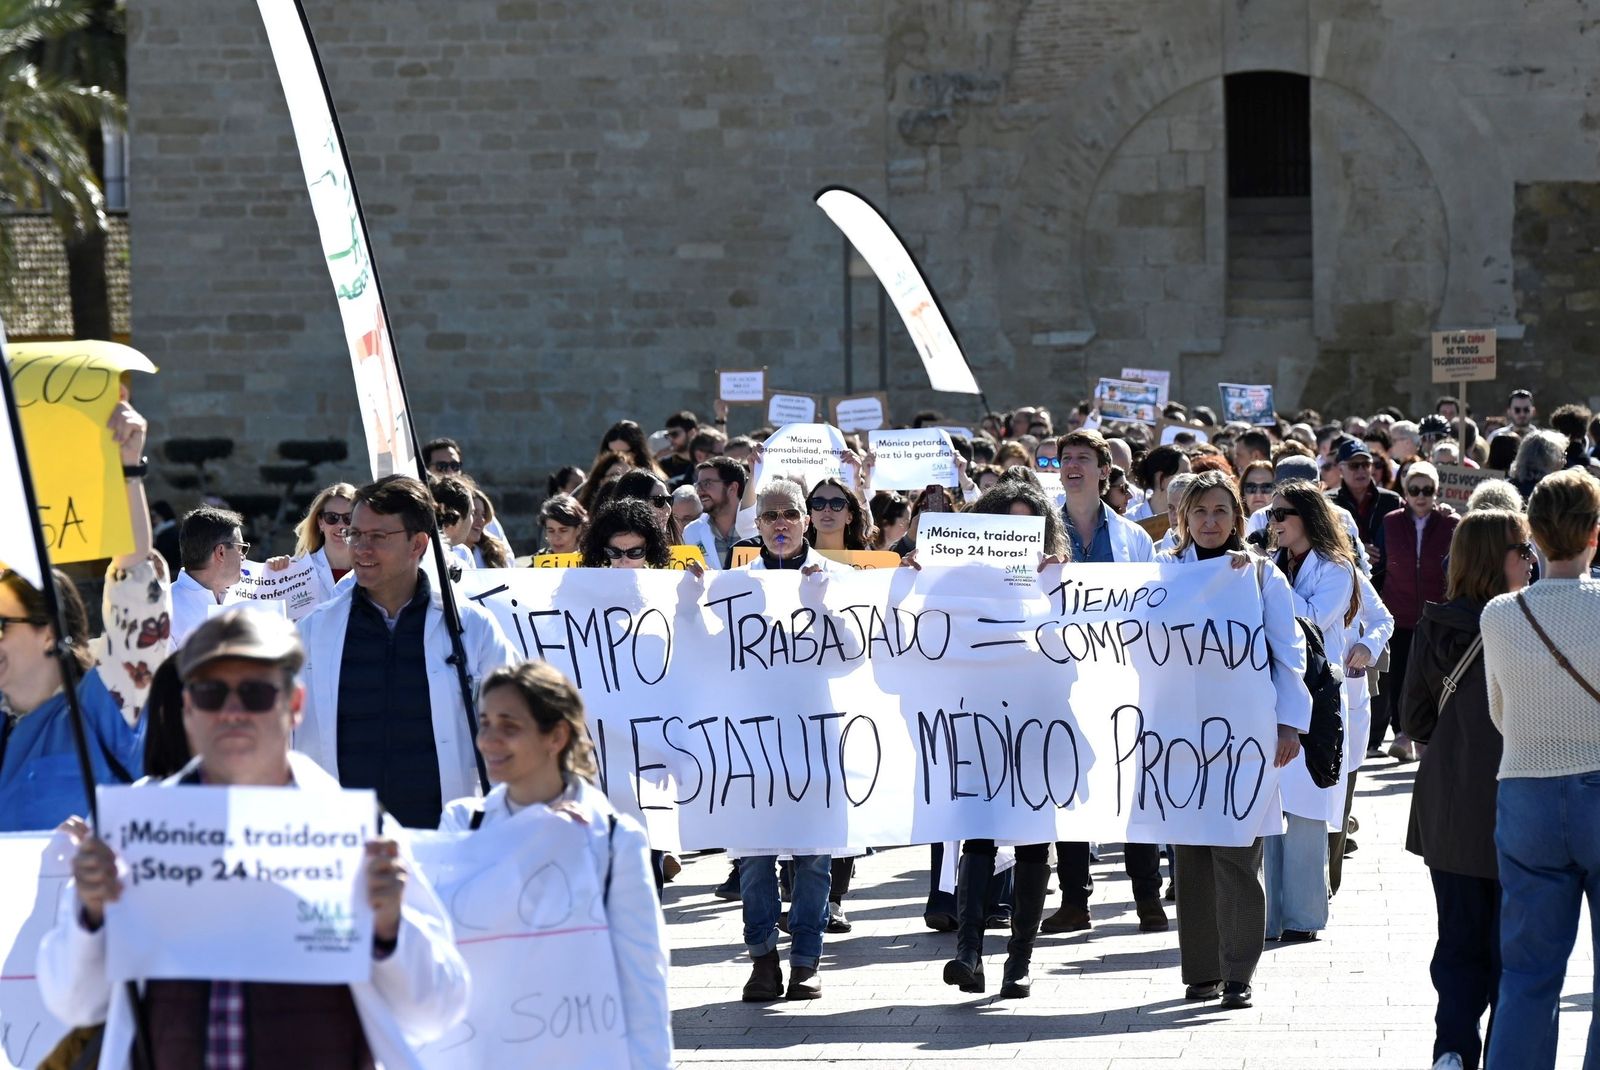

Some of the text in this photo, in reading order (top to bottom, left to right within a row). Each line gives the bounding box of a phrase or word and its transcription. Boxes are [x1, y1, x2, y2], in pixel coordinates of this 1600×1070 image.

[760, 446, 821, 455] esponsabilidad,
[893, 451, 902, 459] tú
[903, 450, 912, 459] la
[914, 449, 953, 460] guardia!
[927, 526, 1041, 543] ¡Mónica, traidora!
[931, 543, 1028, 558] ¡Stop 24 horas!
[240, 577, 277, 587] uardias
[235, 588, 258, 600] vidas
[704, 591, 951, 672] TRABAJADO
[1035, 618, 1269, 672] COMPUTADO
[629, 712, 881, 815] ESTATUTO
[244, 823, 367, 848] traidora!
[131, 858, 344, 886] ¡Stop 24 horas!
[502, 992, 627, 1045] SOMO
